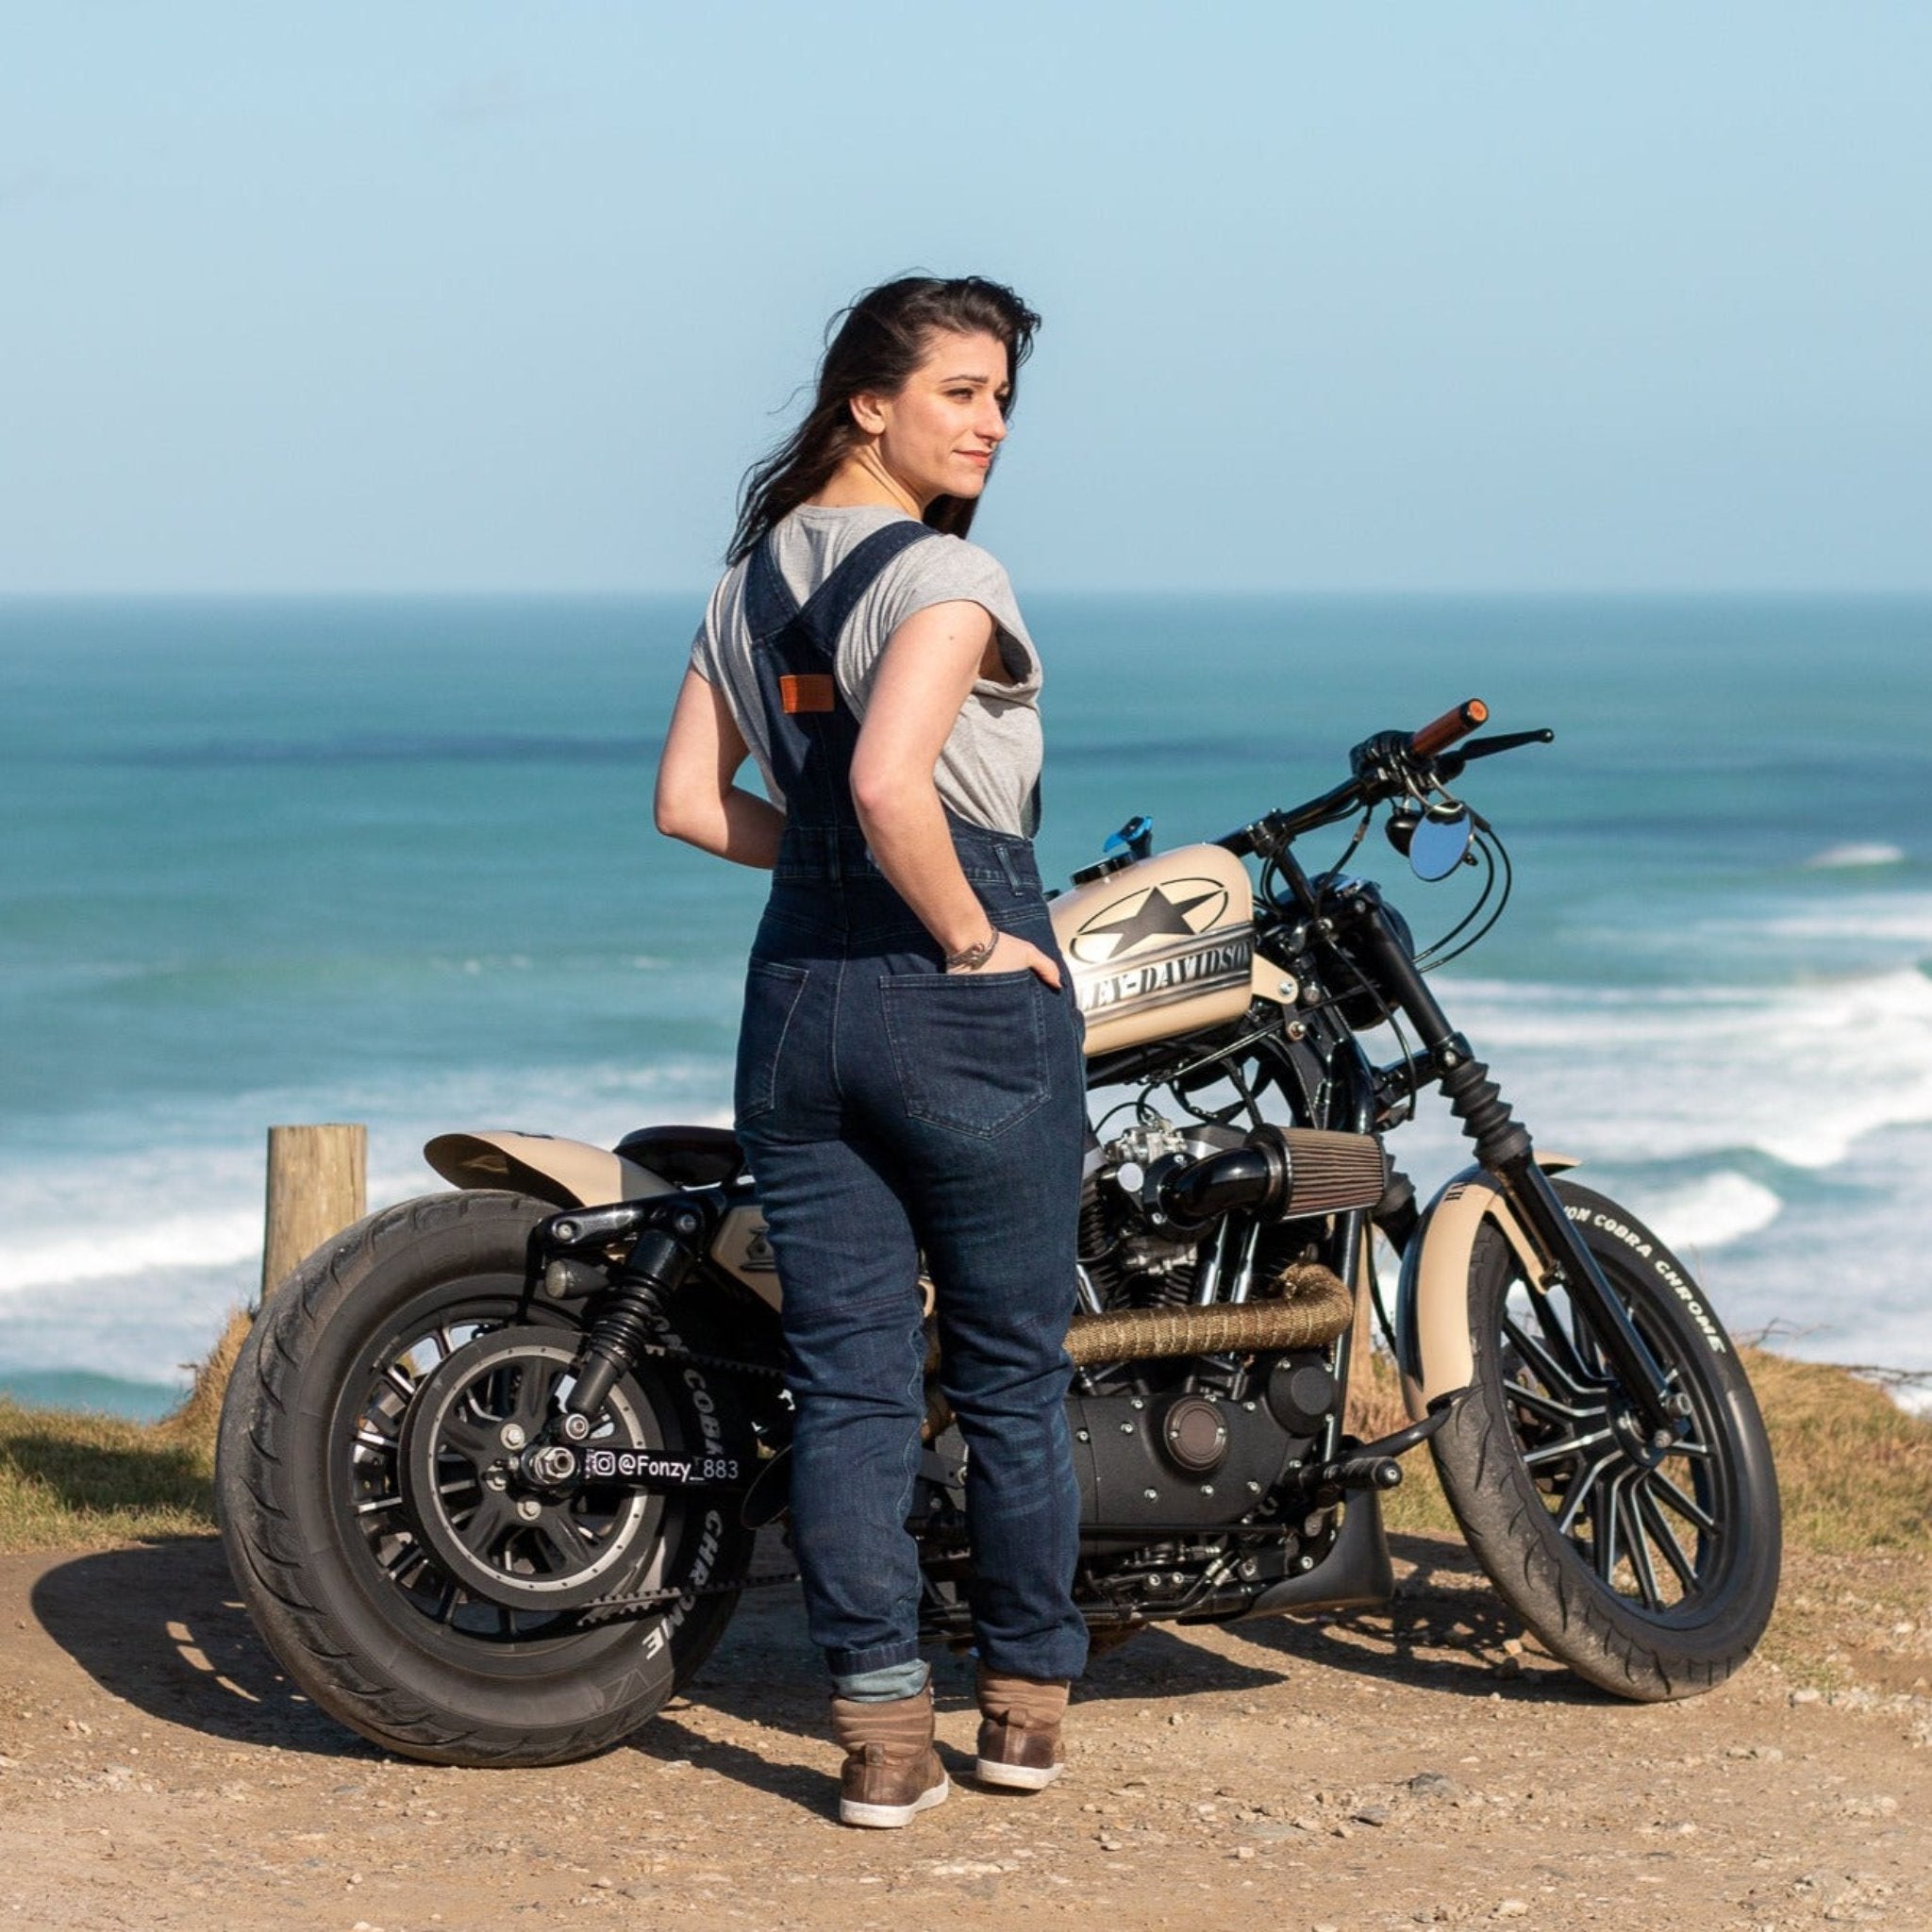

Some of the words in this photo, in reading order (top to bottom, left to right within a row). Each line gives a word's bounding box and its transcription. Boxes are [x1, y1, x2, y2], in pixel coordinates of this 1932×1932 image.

[1564, 1206, 1591, 1223] ON
[1593, 1214, 1653, 1258] COBRA
[1654, 1260, 1726, 1354] CHROME
[618, 1454, 739, 1483] @Fonzy_883
